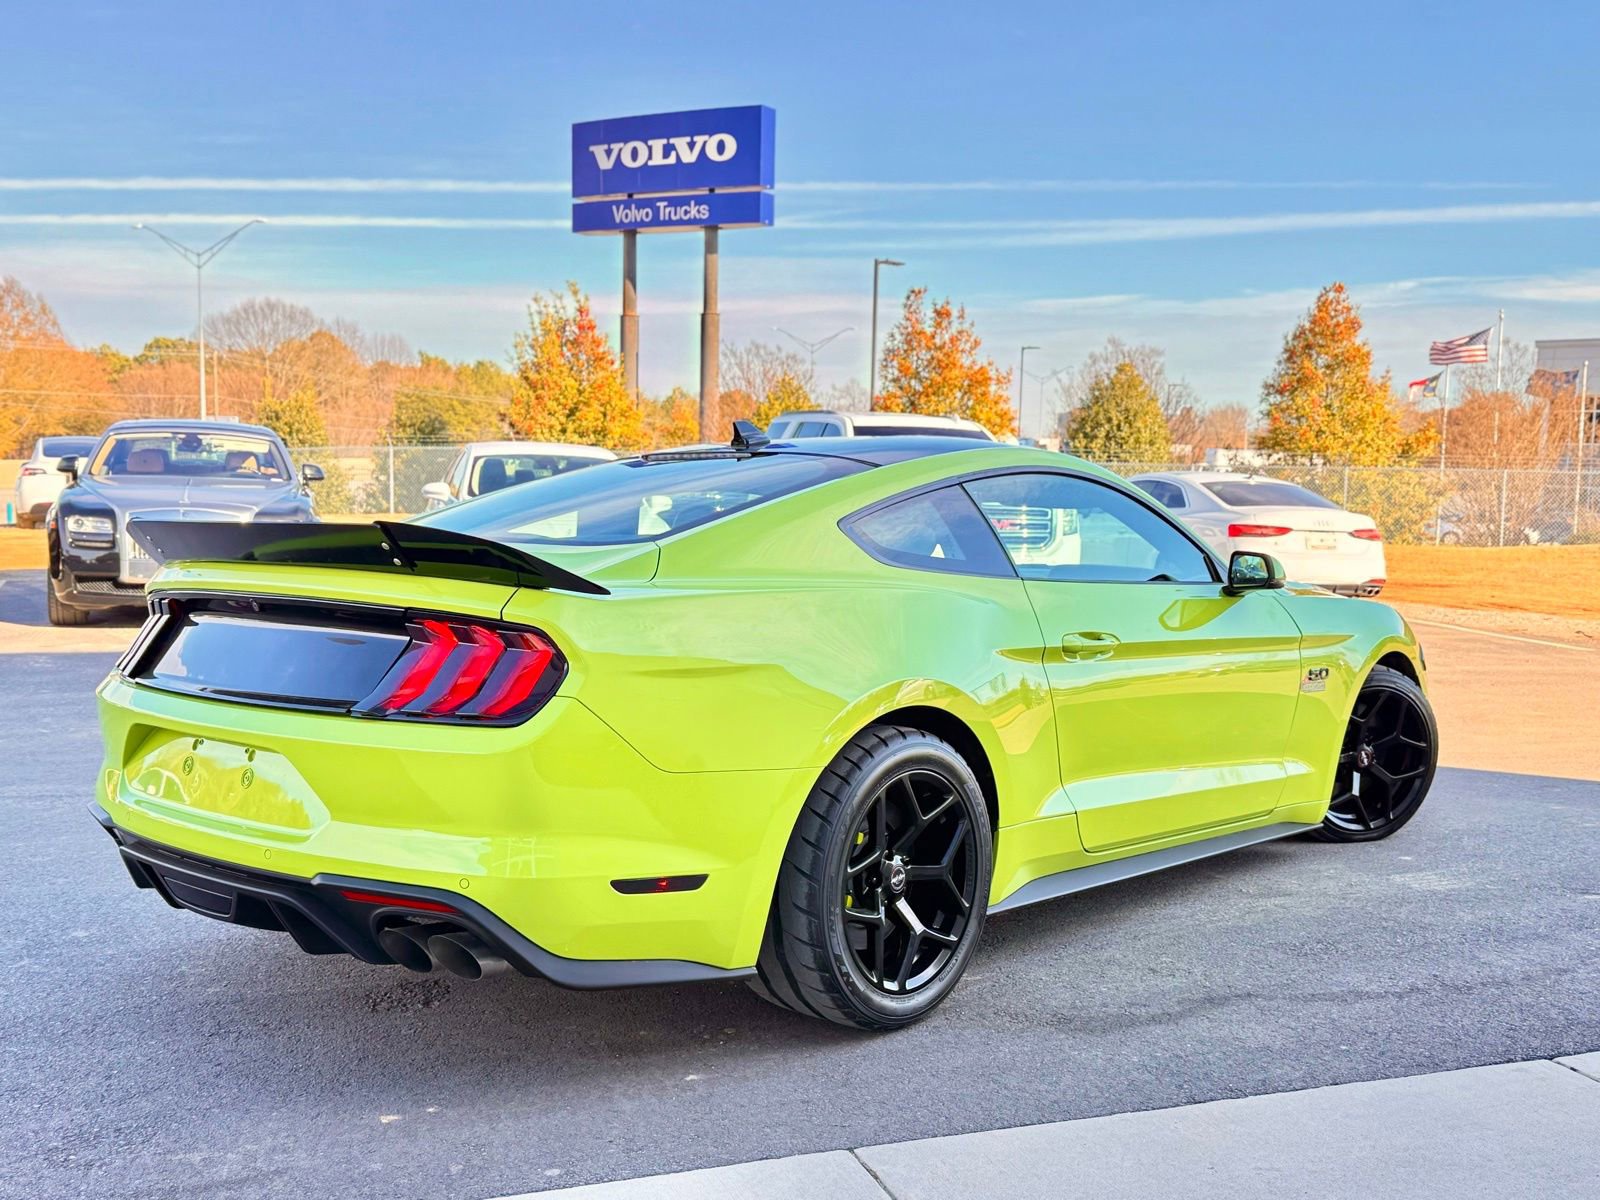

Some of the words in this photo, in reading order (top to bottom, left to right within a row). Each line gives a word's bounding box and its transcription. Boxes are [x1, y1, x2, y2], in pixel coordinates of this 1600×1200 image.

[589, 133, 737, 170] VOLVO
[612, 204, 652, 224] Volvo
[656, 200, 709, 220] Trucks
